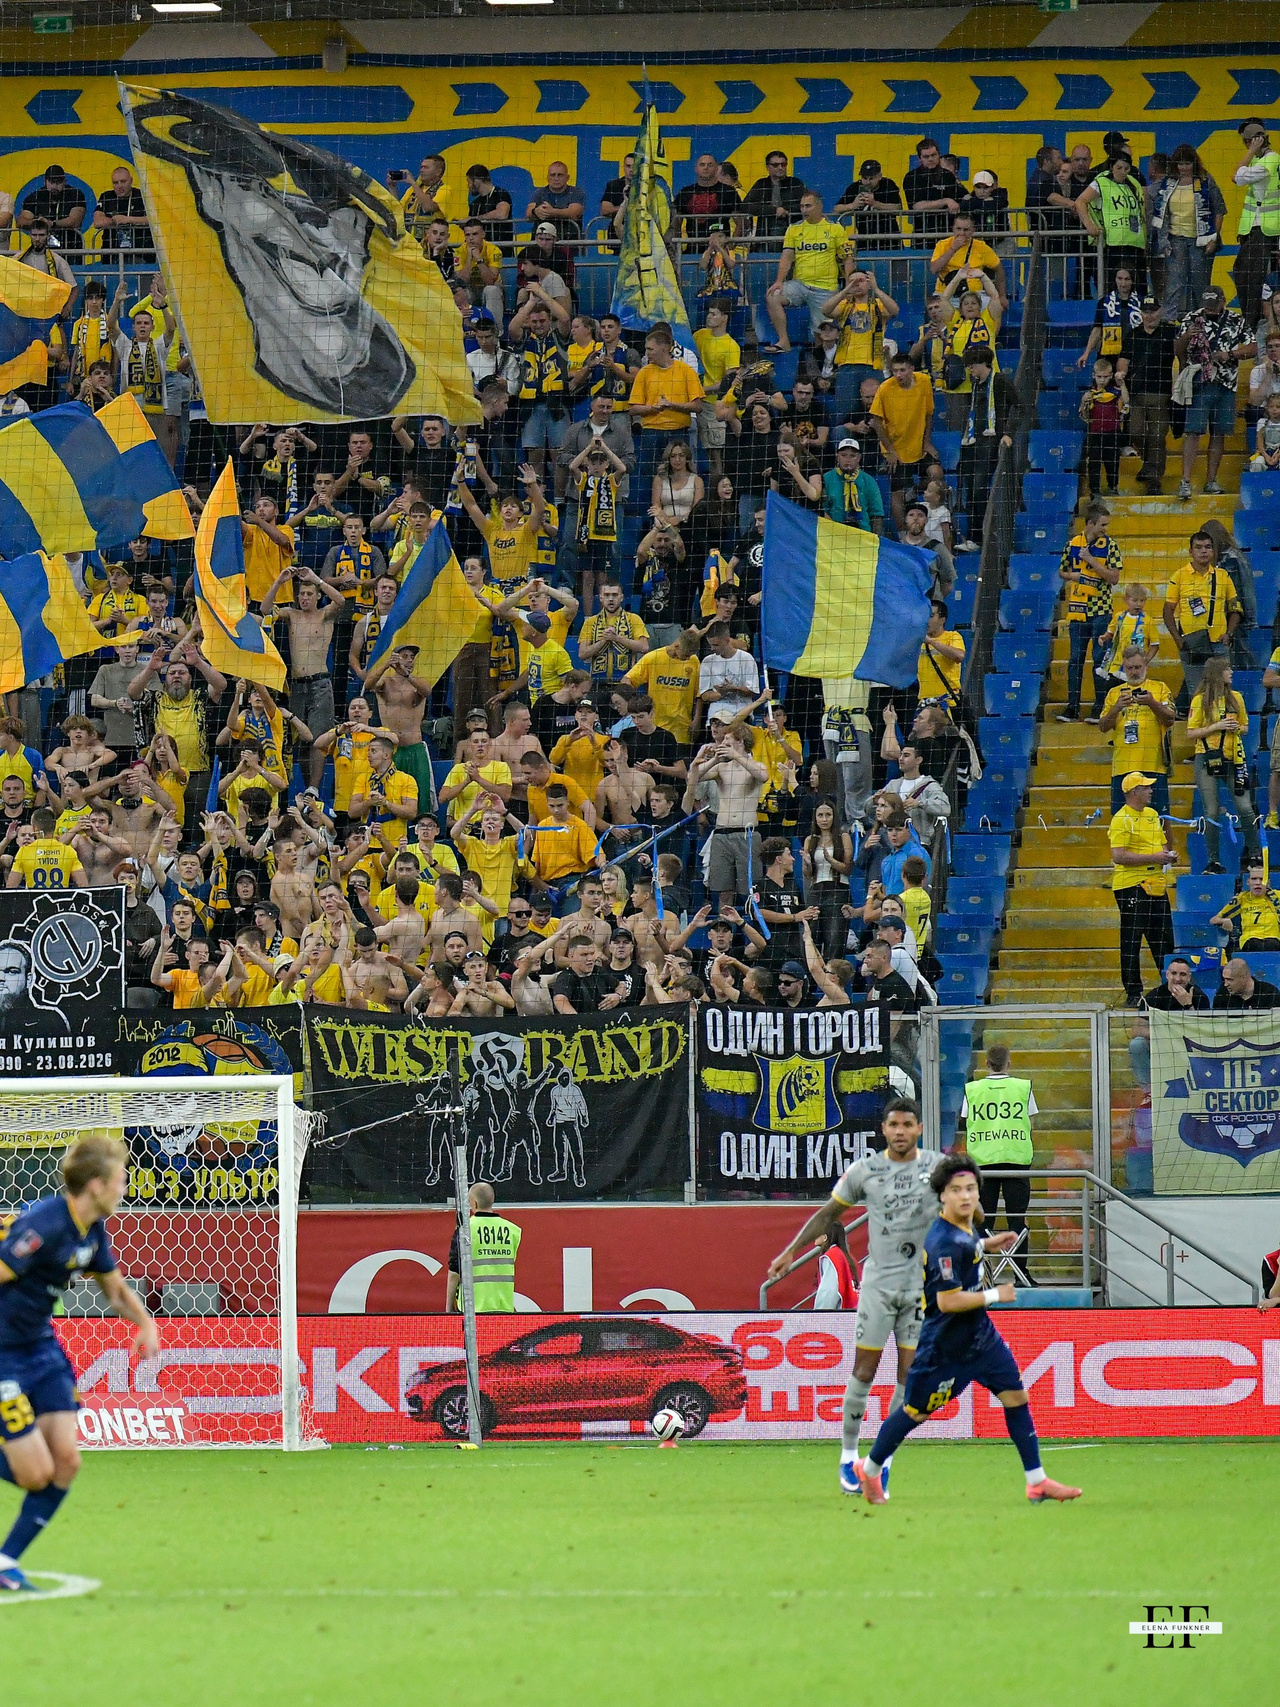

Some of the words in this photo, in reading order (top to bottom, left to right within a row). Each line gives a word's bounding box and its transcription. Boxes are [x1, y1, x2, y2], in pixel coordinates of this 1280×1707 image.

[797, 242, 827, 251] Jeep
[656, 675, 690, 688] RUSSIA
[33, 868, 64, 888] 88
[56, 903, 100, 921] LADS
[1253, 912, 1262, 924] 7
[706, 1008, 784, 1057] ОДИН
[793, 1006, 883, 1055] ГОРОД
[13, 1034, 97, 1054] Кулишов
[36, 1053, 113, 1070] 23.08.2026
[148, 1048, 181, 1066] 2012
[320, 1026, 470, 1083] WEST
[524, 1025, 685, 1080] BAND
[1205, 1089, 1280, 1113] СЕКТОР
[972, 1101, 1024, 1121] K032
[1231, 1113, 1277, 1122] РОСТОВ
[969, 1130, 1027, 1143] STEWARD
[720, 1131, 798, 1181] ОДИН
[194, 1167, 279, 1200] УЛЬТР
[476, 1226, 511, 1245] 18142
[477, 1248, 512, 1256] STEWARD
[75, 1406, 187, 1443] ONBET
